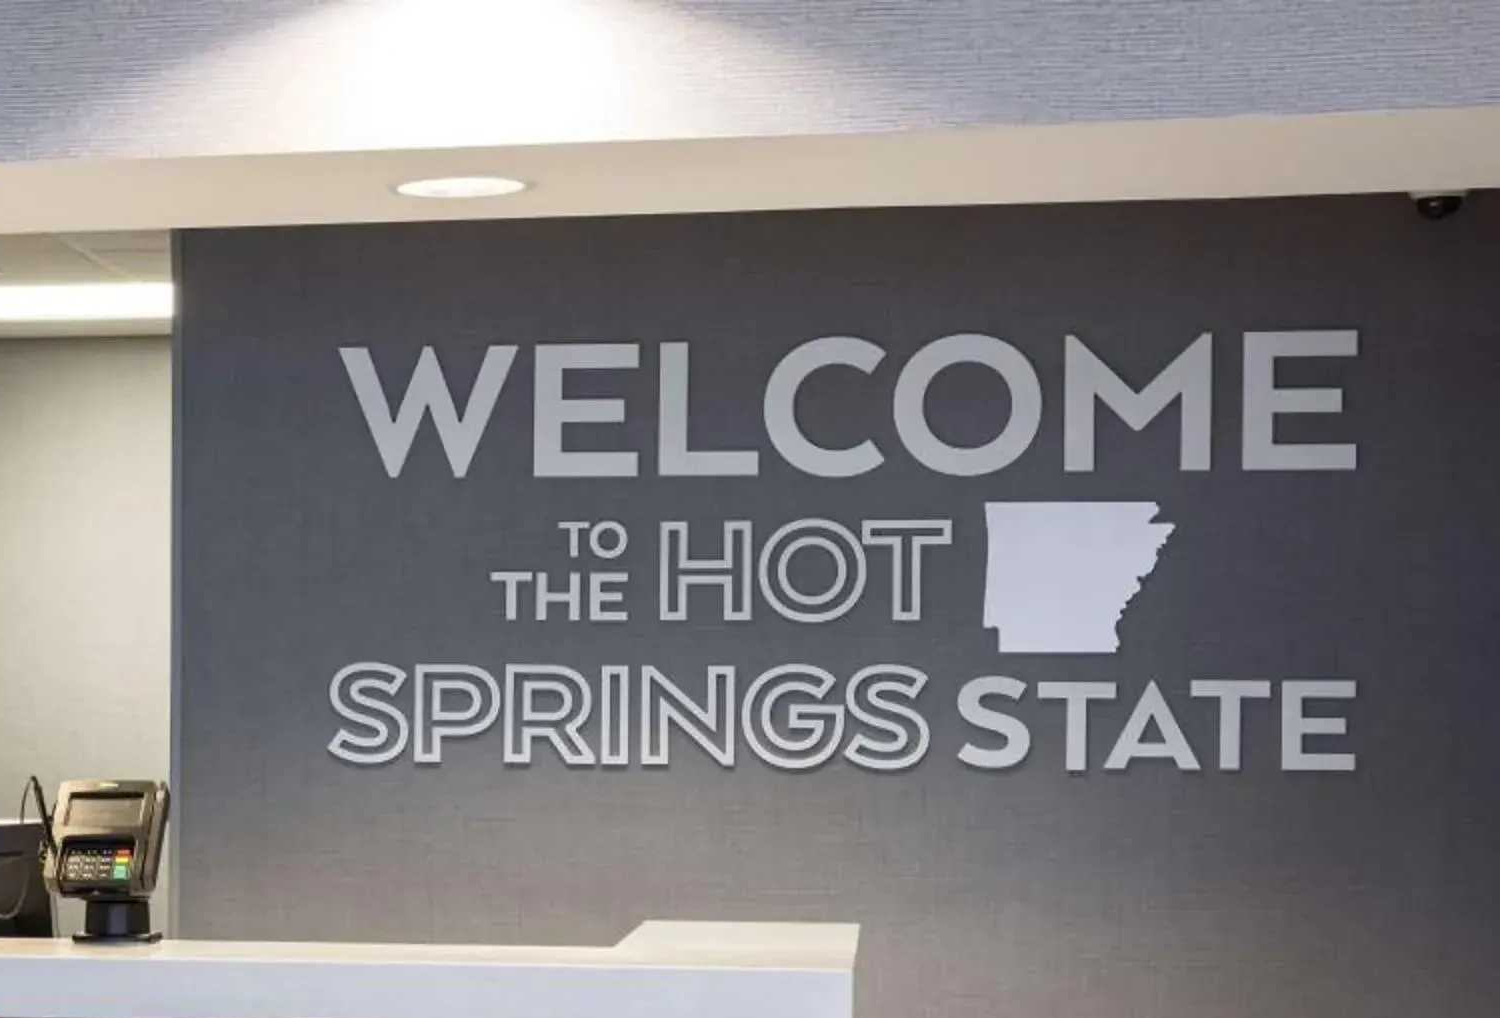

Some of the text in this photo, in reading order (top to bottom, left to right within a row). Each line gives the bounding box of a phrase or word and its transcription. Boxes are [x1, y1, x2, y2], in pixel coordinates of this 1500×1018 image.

[338, 330, 1357, 479] WELCOME
[490, 518, 954, 623] THE HOT
[558, 520, 629, 559] TO
[326, 662, 1356, 771] SPRINGS STATE
